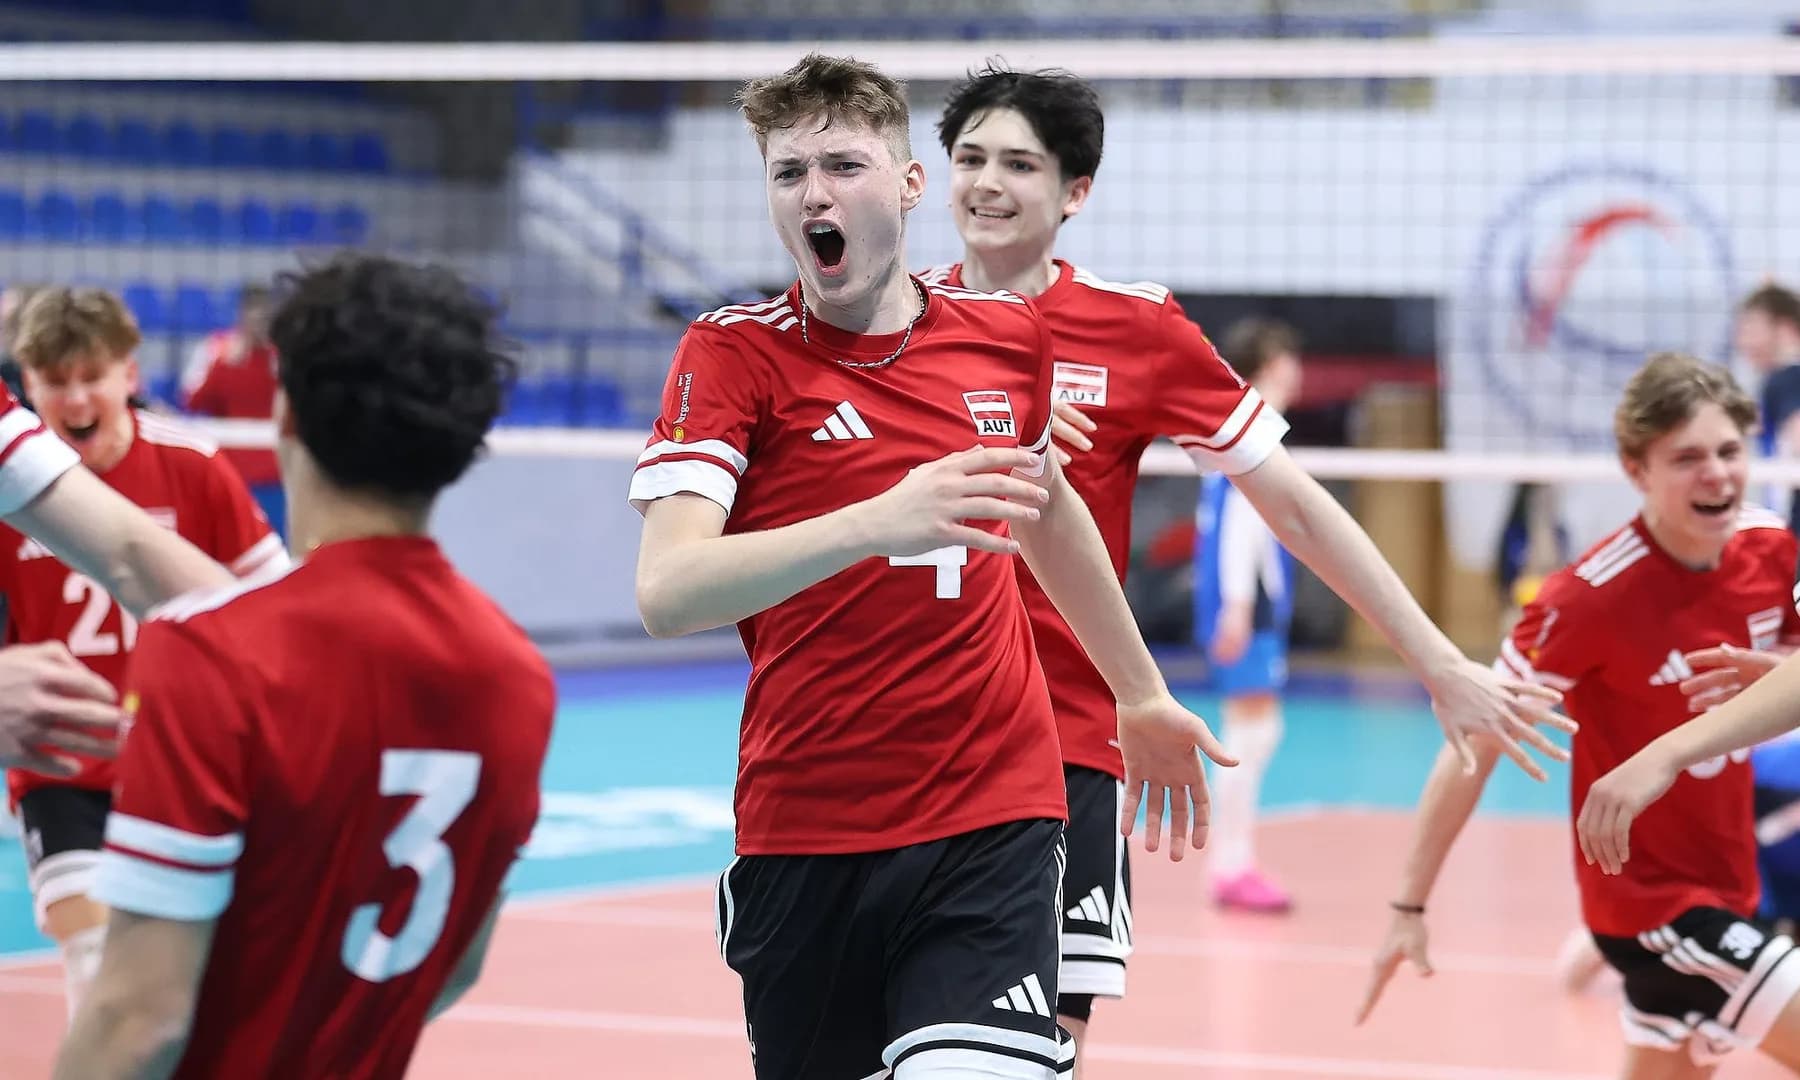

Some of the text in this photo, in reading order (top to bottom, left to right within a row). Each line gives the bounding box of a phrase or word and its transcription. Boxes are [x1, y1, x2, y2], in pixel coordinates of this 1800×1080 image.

[1058, 390, 1098, 402] AUT
[983, 420, 1012, 434] AUT
[341, 749, 482, 983] 3
